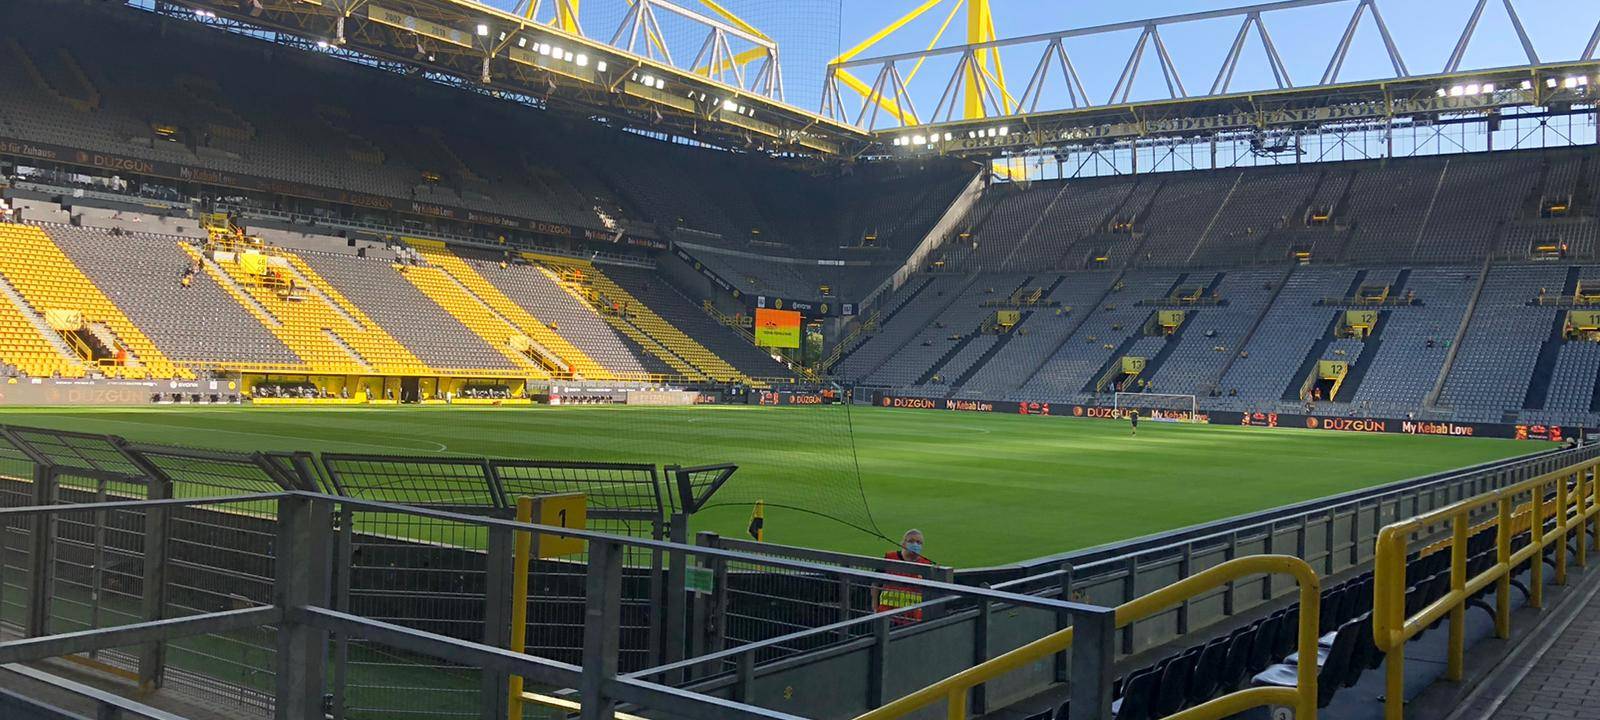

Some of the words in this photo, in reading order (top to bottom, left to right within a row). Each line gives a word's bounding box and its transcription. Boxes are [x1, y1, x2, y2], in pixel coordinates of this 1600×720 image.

[1361, 314, 1372, 323] 12
[1589, 314, 1599, 324] 11
[1331, 364, 1343, 374] 12
[946, 399, 956, 411] My
[956, 400, 977, 411] Kebab
[977, 401, 993, 411] Love
[1324, 418, 1385, 432] DÜZGÜN
[1402, 421, 1416, 434] My
[1418, 421, 1448, 434] Kebab
[1449, 423, 1473, 436] Love
